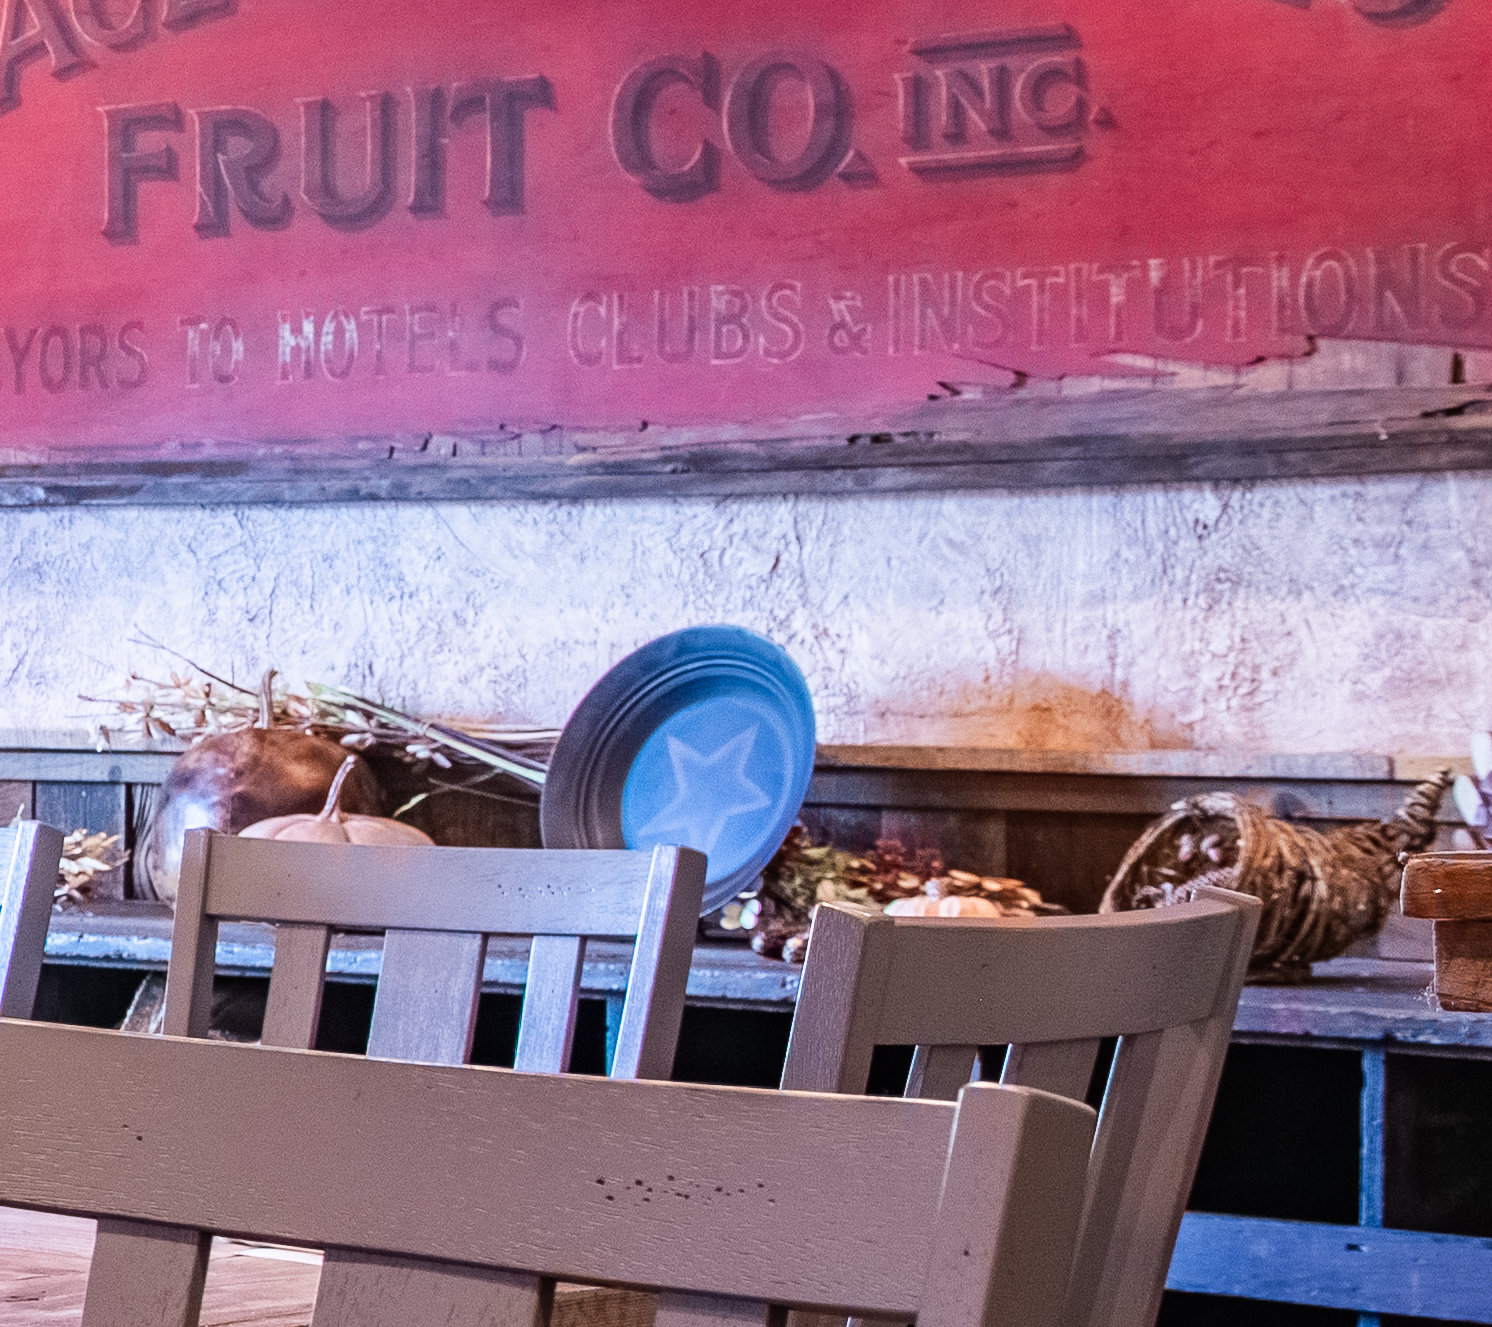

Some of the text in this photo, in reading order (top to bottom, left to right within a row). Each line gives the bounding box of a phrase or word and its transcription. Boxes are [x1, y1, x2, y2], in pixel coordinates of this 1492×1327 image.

[96, 74, 557, 247] FRUIT
[607, 46, 881, 203] CO.
[178, 314, 245, 390] TO
[274, 295, 525, 388] HOTELS
[566, 277, 806, 372] CLUBS
[826, 284, 873, 358] &
[887, 239, 1490, 358] INSTITUTIONS
